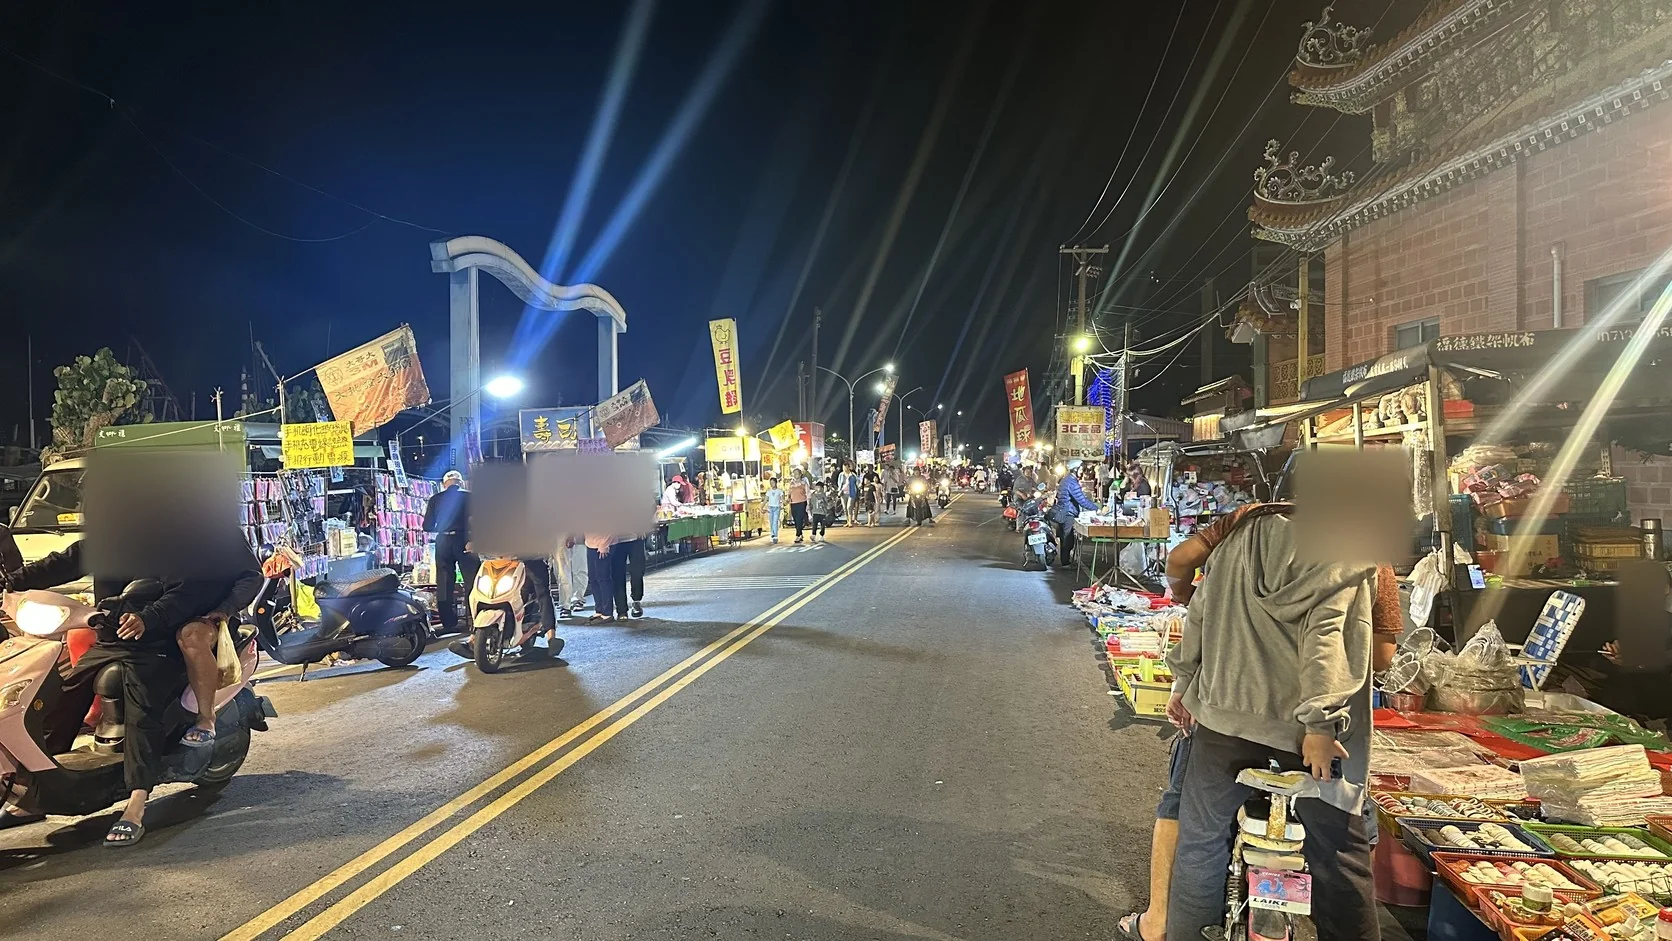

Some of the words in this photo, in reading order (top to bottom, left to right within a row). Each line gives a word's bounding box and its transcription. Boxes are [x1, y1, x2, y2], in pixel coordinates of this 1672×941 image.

[1010, 385, 1032, 443] 地瓜球
[533, 415, 577, 444] 壽司
[1061, 424, 1101, 434] 3C產品
[1253, 898, 1289, 907] LAIKE
